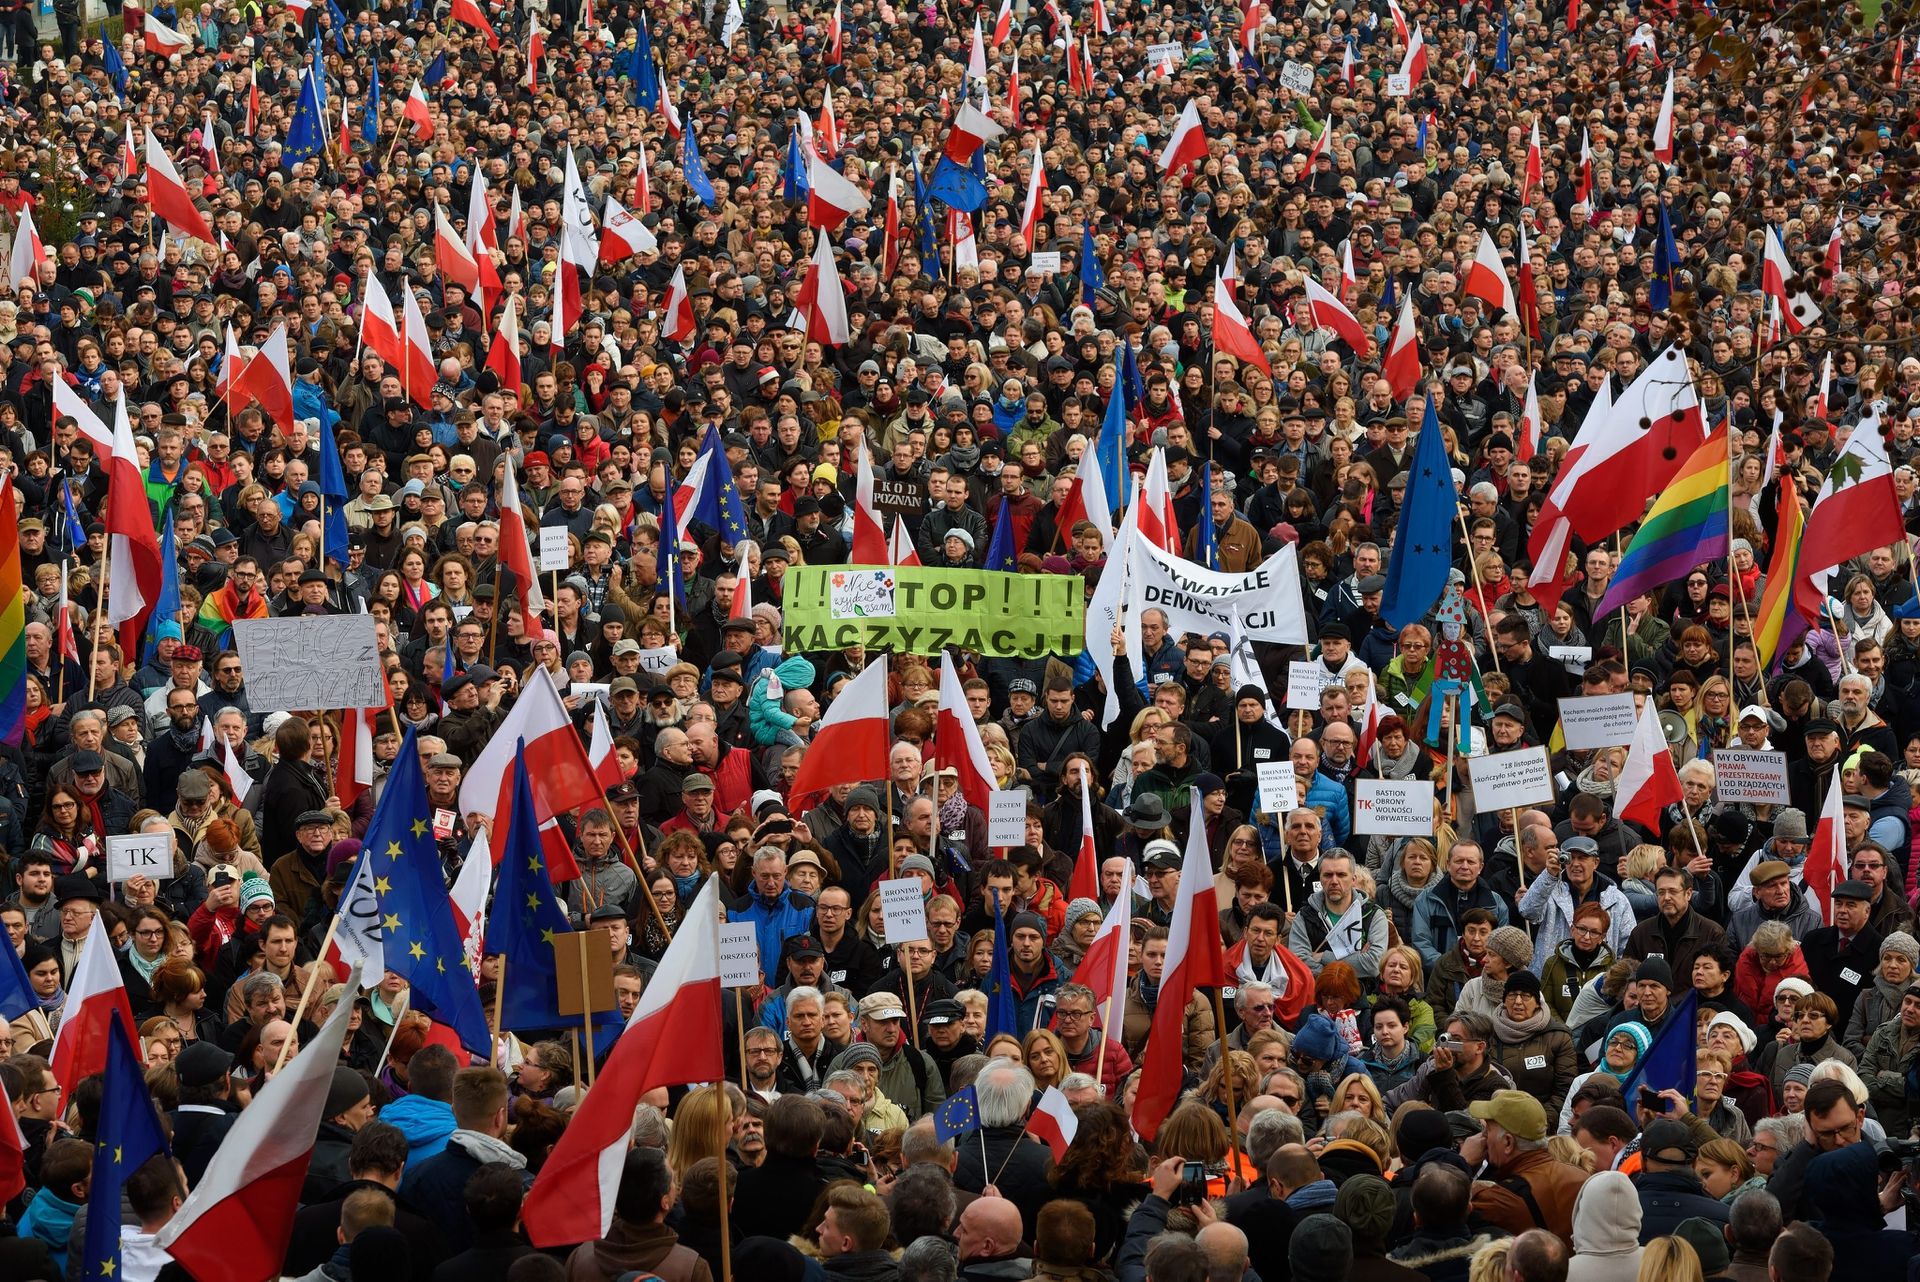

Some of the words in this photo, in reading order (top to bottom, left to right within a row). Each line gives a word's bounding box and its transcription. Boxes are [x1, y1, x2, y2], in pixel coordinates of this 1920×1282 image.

[844, 573, 877, 592] Nie
[899, 582, 986, 610] TOP
[245, 618, 359, 671] PRECZ
[355, 645, 374, 662] Z
[784, 624, 1072, 656] KACZYZACJI
[643, 654, 668, 669] TK
[1560, 653, 1583, 666] TK
[249, 666, 383, 710] KACZYZMEM
[1586, 705, 1604, 713] moich
[1578, 714, 1618, 723] doprowadzają
[1513, 757, 1544, 768] listopada
[1733, 754, 1783, 765] OBYWATELE
[1261, 768, 1292, 776] BRONIMY
[1474, 773, 1506, 784] skończyło
[1507, 770, 1517, 778] się
[1525, 765, 1546, 774] Polsce
[1718, 771, 1782, 781] PRZESTRZEGAMY
[1263, 785, 1293, 793] BRONIMY
[1492, 779, 1522, 790] państwo
[1737, 780, 1786, 790] RZĄDZĄCYCH
[1720, 788, 1741, 796] TEGO
[1742, 787, 1775, 798] ŻĄDAMY
[1272, 799, 1288, 808] KOD
[1375, 798, 1406, 806] OBRONY
[1375, 806, 1413, 814] WOLNOŚCI
[990, 816, 1026, 824] GORSZEGO
[1374, 814, 1432, 823] OBYWATELSKICH
[124, 846, 159, 867] TK
[884, 887, 920, 897] BRONIMY
[887, 908, 922, 919] BRONIMY
[720, 935, 750, 944] JESTEM
[720, 951, 758, 961] ORSZEGO
[723, 971, 751, 980] SORTU!
[1843, 968, 1860, 981] KOD
[1526, 1056, 1544, 1066] KOD
